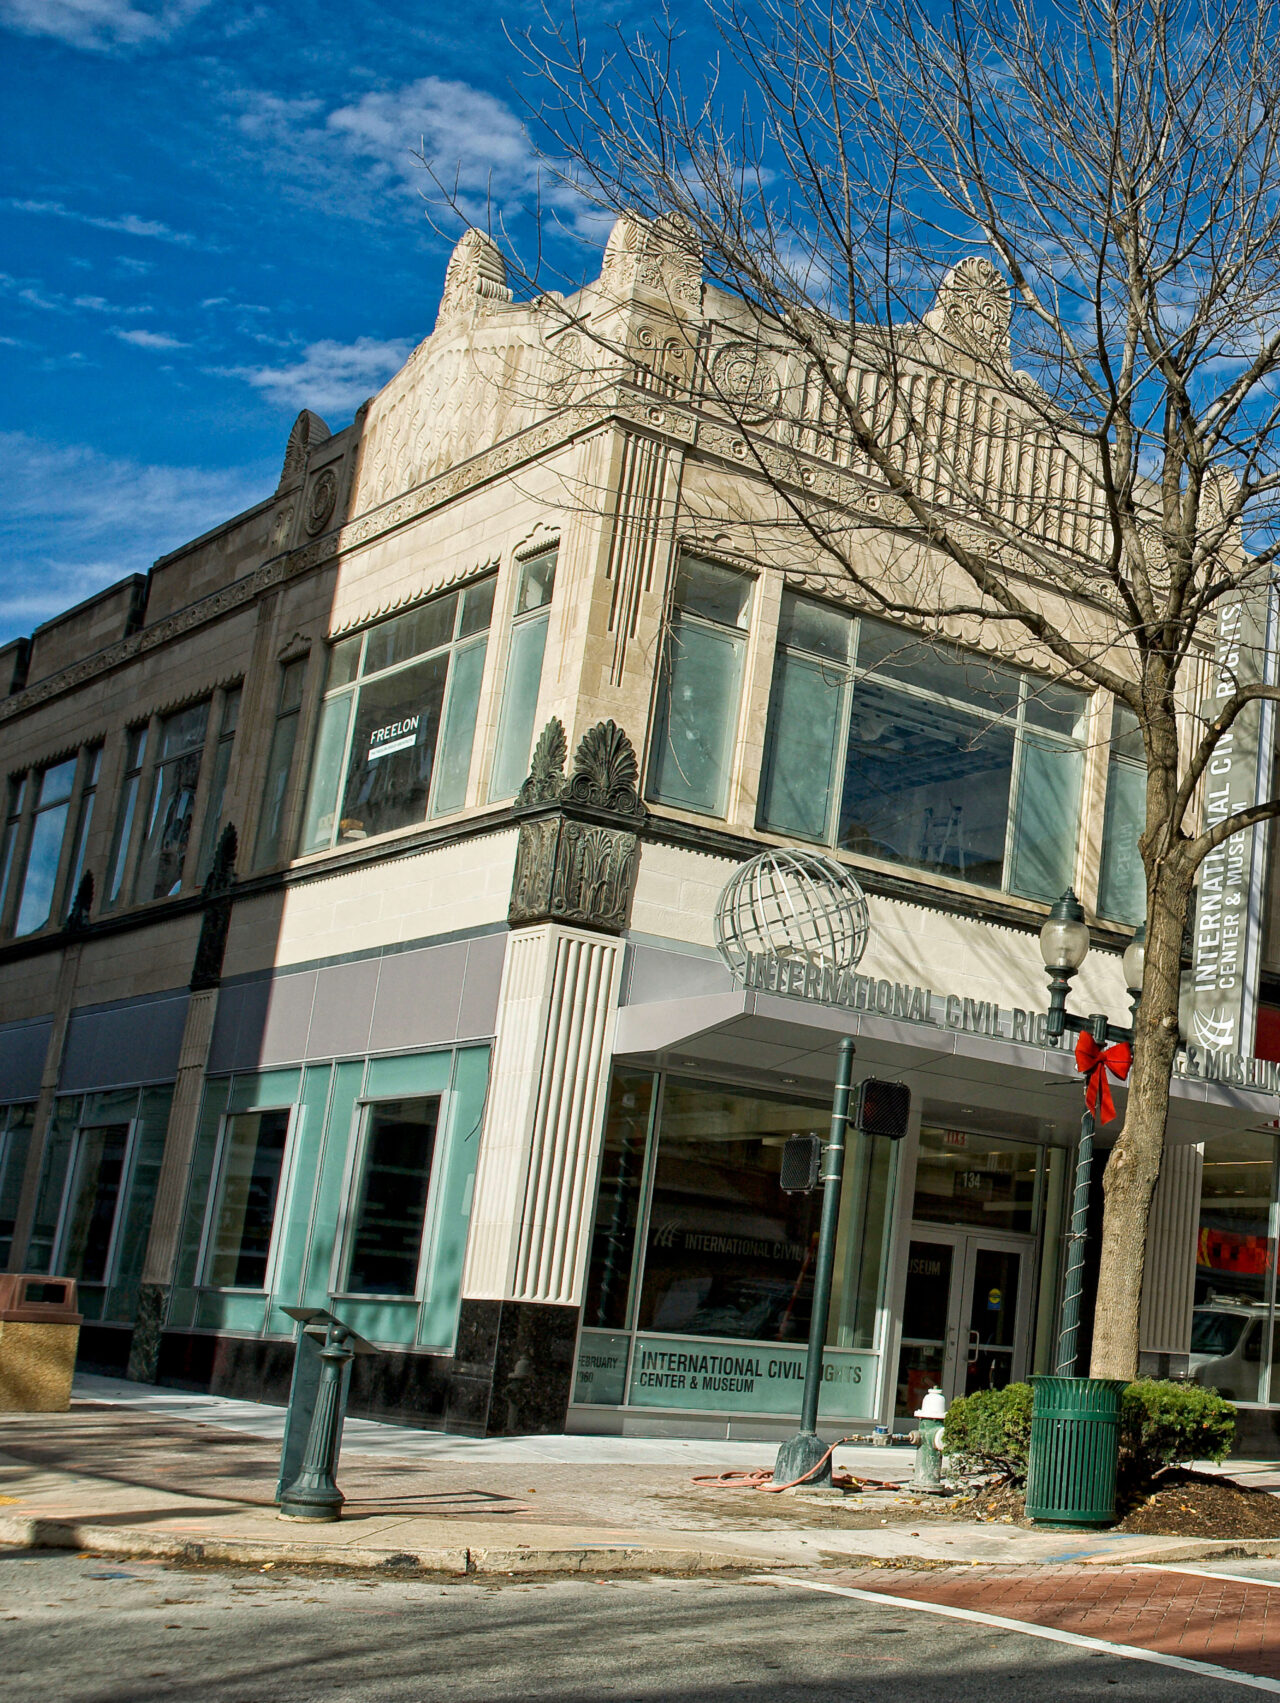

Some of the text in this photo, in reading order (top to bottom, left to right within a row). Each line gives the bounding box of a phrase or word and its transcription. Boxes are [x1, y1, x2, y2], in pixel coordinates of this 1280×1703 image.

[1216, 603, 1242, 699] RIGHTS
[370, 715, 420, 745] FREELON
[1210, 714, 1234, 776] CIV
[1219, 801, 1247, 989] CENTER & MUSEM
[743, 950, 937, 1024] INTERNATIONAL
[944, 994, 1005, 1037] CIVIL
[1011, 1007, 1080, 1054] RIG
[1186, 1046, 1200, 1076] &
[963, 1172, 981, 1190] 134
[684, 1232, 771, 1258] INTERNATIONAL
[908, 1258, 941, 1276] USEUM
[639, 1371, 755, 1394] CENTER & MUSEUM
[641, 1350, 862, 1385] INTERNATIONAL CIVIL IGHTS
